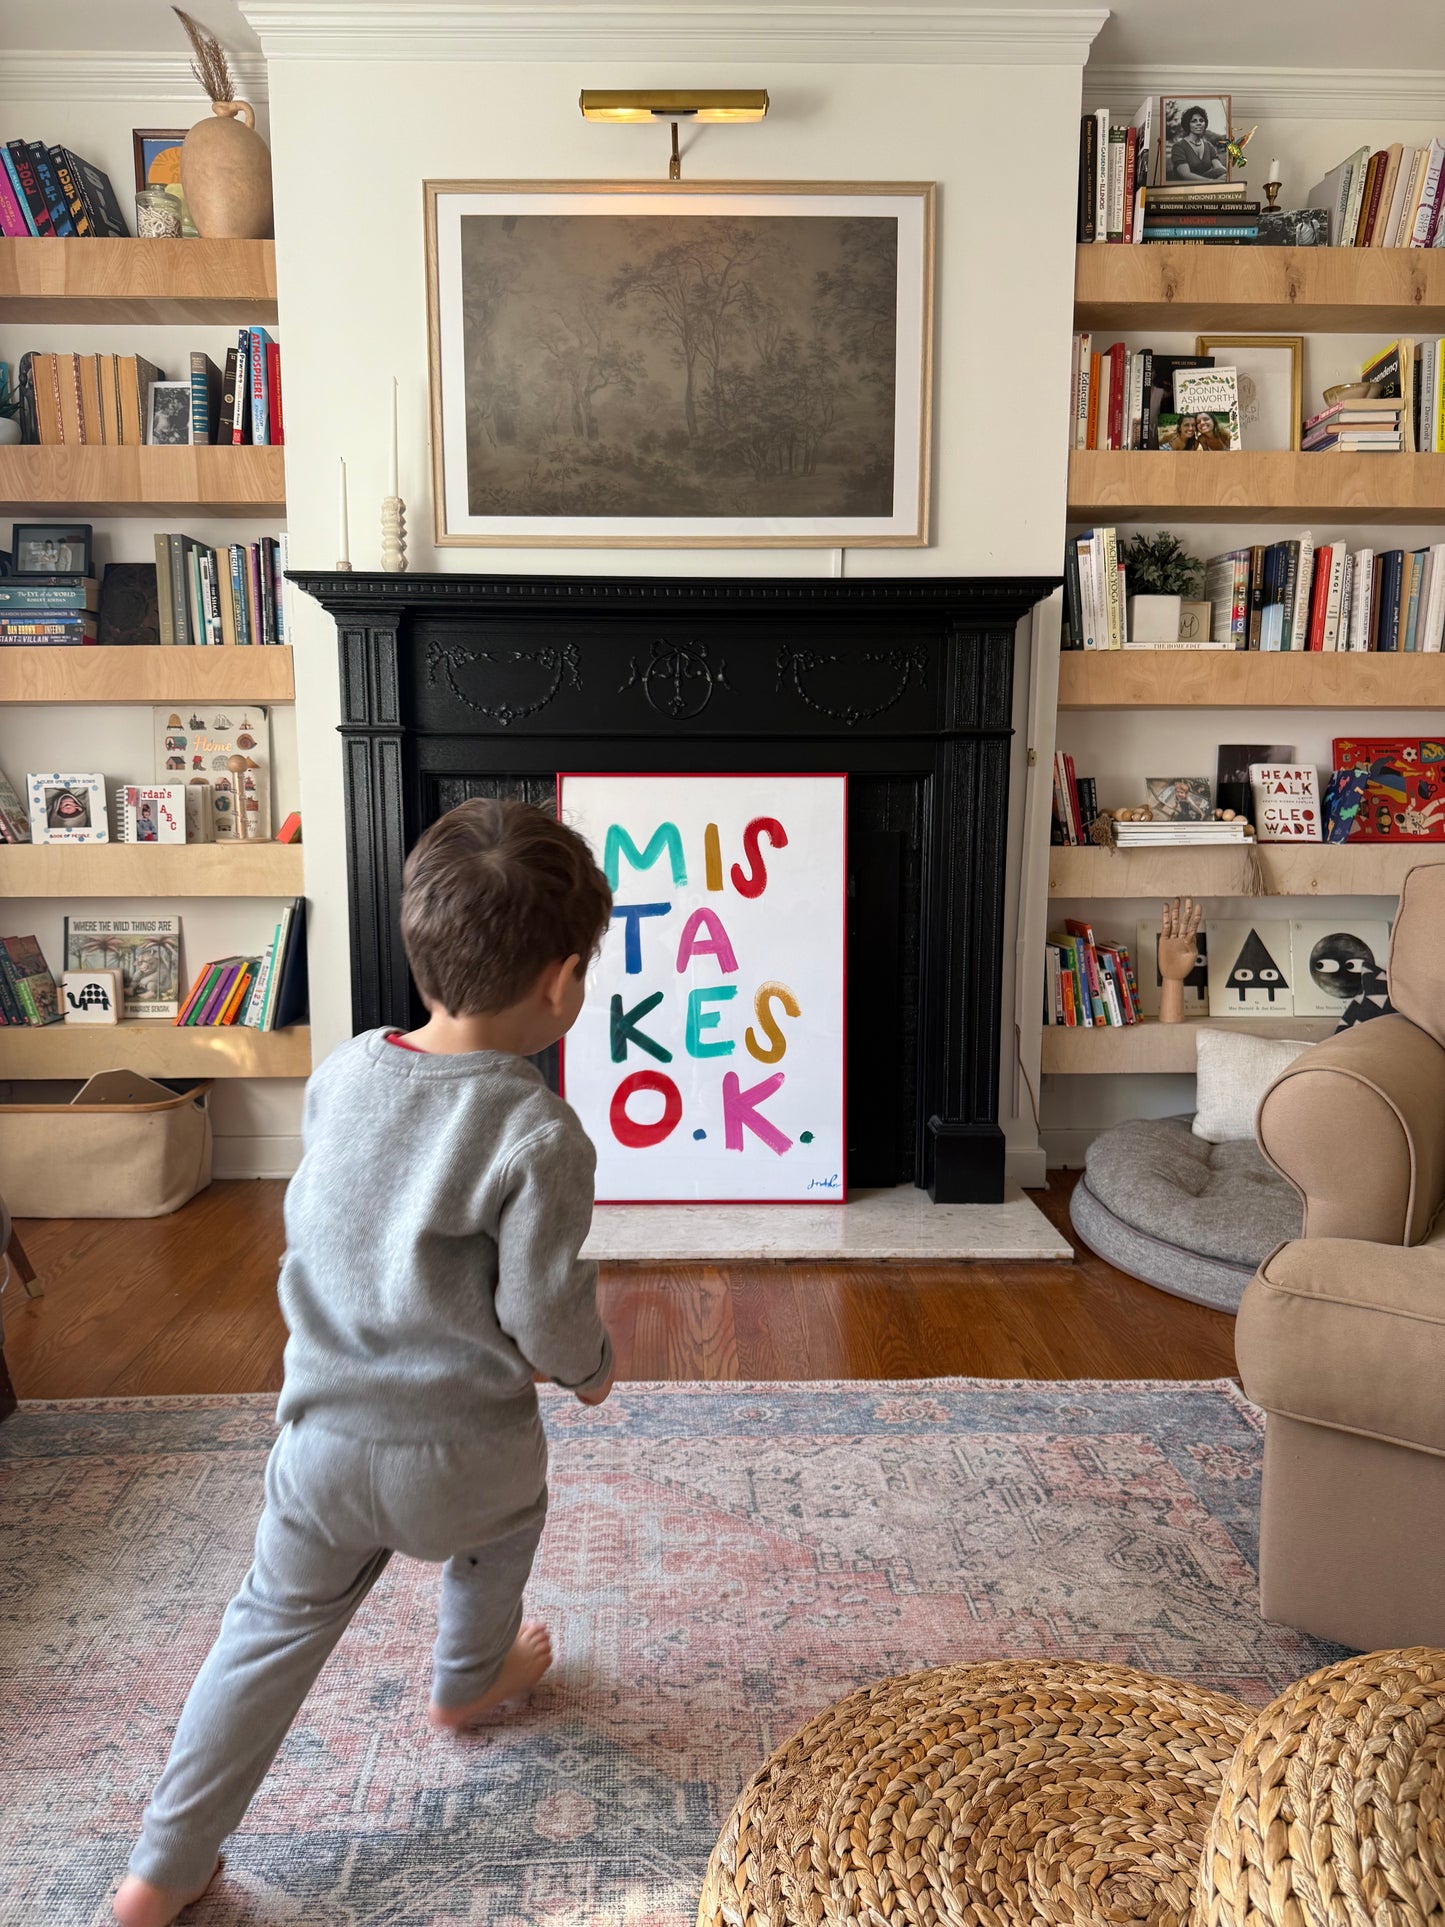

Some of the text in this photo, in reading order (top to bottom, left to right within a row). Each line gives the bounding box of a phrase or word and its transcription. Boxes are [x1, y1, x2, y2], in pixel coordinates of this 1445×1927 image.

[16, 162, 36, 195] WOOL
[37, 164, 56, 202] SHIFT
[58, 169, 74, 198] DUST
[1424, 168, 1439, 197] FLO
[1422, 214, 1430, 233] ALISA
[251, 333, 262, 400] ATMOSPHERE
[1080, 372, 1089, 419] Educated
[1181, 394, 1235, 404] ASHWORTH
[1189, 386, 1226, 395] DONNA
[1109, 534, 1117, 578] TEACHING
[1300, 558, 1311, 594] Atomic
[1333, 562, 1341, 593] RANGE
[1284, 584, 1293, 620] INFLUENCE
[1297, 596, 1307, 626] Habits
[7, 625, 65, 634] DAN BROWN INFERNO
[193, 736, 232, 752] Home
[1261, 770, 1311, 780] HEART
[1262, 782, 1312, 795] TALK
[141, 788, 172, 799] rdan's
[160, 805, 176, 830] A B C
[1264, 809, 1314, 821] CLEO
[1265, 823, 1316, 835] WADE
[604, 816, 788, 899] MIS
[73, 921, 172, 931] WHERE THE WILD THINGS ARE
[611, 902, 739, 975] TA
[610, 980, 802, 1064] KES
[609, 1070, 815, 1156] O.K.
